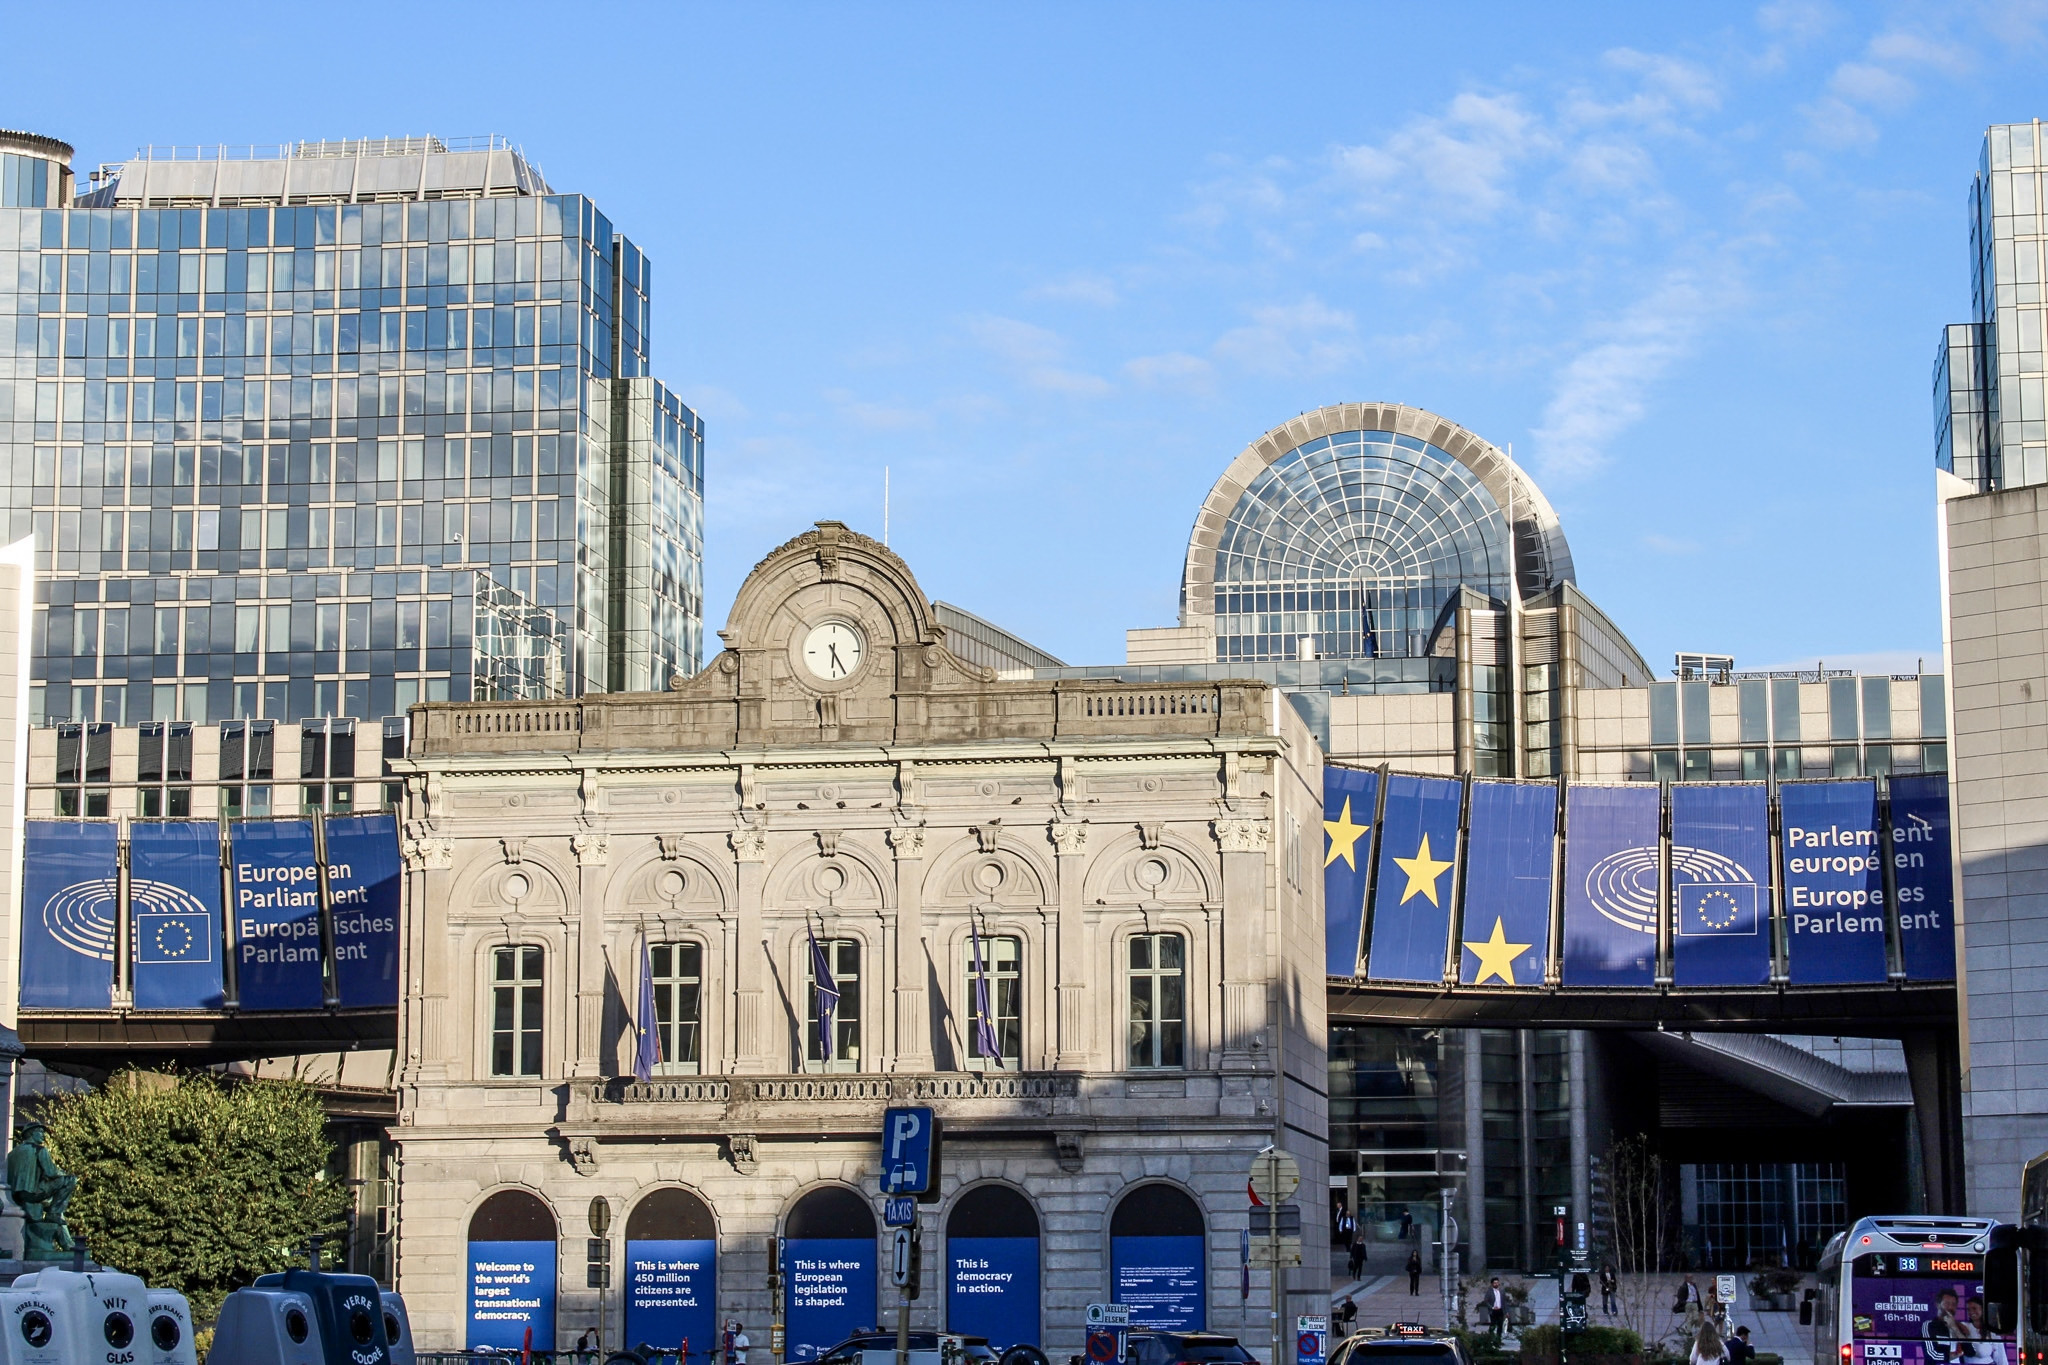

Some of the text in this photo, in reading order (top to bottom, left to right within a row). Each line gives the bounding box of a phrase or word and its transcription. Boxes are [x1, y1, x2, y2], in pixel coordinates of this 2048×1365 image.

[1788, 825, 1933, 848] Parlement
[1790, 850, 1924, 876] européen
[238, 864, 352, 886] European
[1792, 886, 1925, 910] Europees
[242, 913, 394, 940] Europäisches
[1794, 910, 1940, 934] Parlement
[242, 942, 368, 964] Parlament
[892, 1113, 920, 1159] P
[887, 1201, 912, 1221] TAXIS
[475, 1262, 535, 1272] Welcome to
[634, 1261, 700, 1270] This is where
[794, 1260, 860, 1270] This is where
[956, 1259, 988, 1268] This is
[1901, 1258, 1974, 1271] 38 Helden
[475, 1274, 530, 1284] the world’s
[634, 1273, 690, 1282] 450 million
[794, 1272, 842, 1283] European
[956, 1271, 1012, 1282] democracy
[475, 1286, 510, 1298] largest
[634, 1285, 673, 1294] citizens
[794, 1284, 848, 1296] legislation
[956, 1284, 1004, 1293] in action.
[14, 1300, 55, 1317] VERRE BLANC
[103, 1298, 128, 1310] WIT
[344, 1295, 372, 1310] VERRE
[474, 1298, 540, 1308] transnational
[634, 1298, 698, 1308] represented.
[794, 1297, 845, 1308] is shaped.
[1875, 1303, 1928, 1311] CENTRAL
[148, 1304, 184, 1320] ERRE BLANC
[474, 1310, 530, 1322] democracy.
[1884, 1314, 1920, 1322] 16h-18h
[1105, 1316, 1126, 1324] ELSENE
[106, 1351, 134, 1364] GLAS
[352, 1345, 384, 1365] COLORÉ
